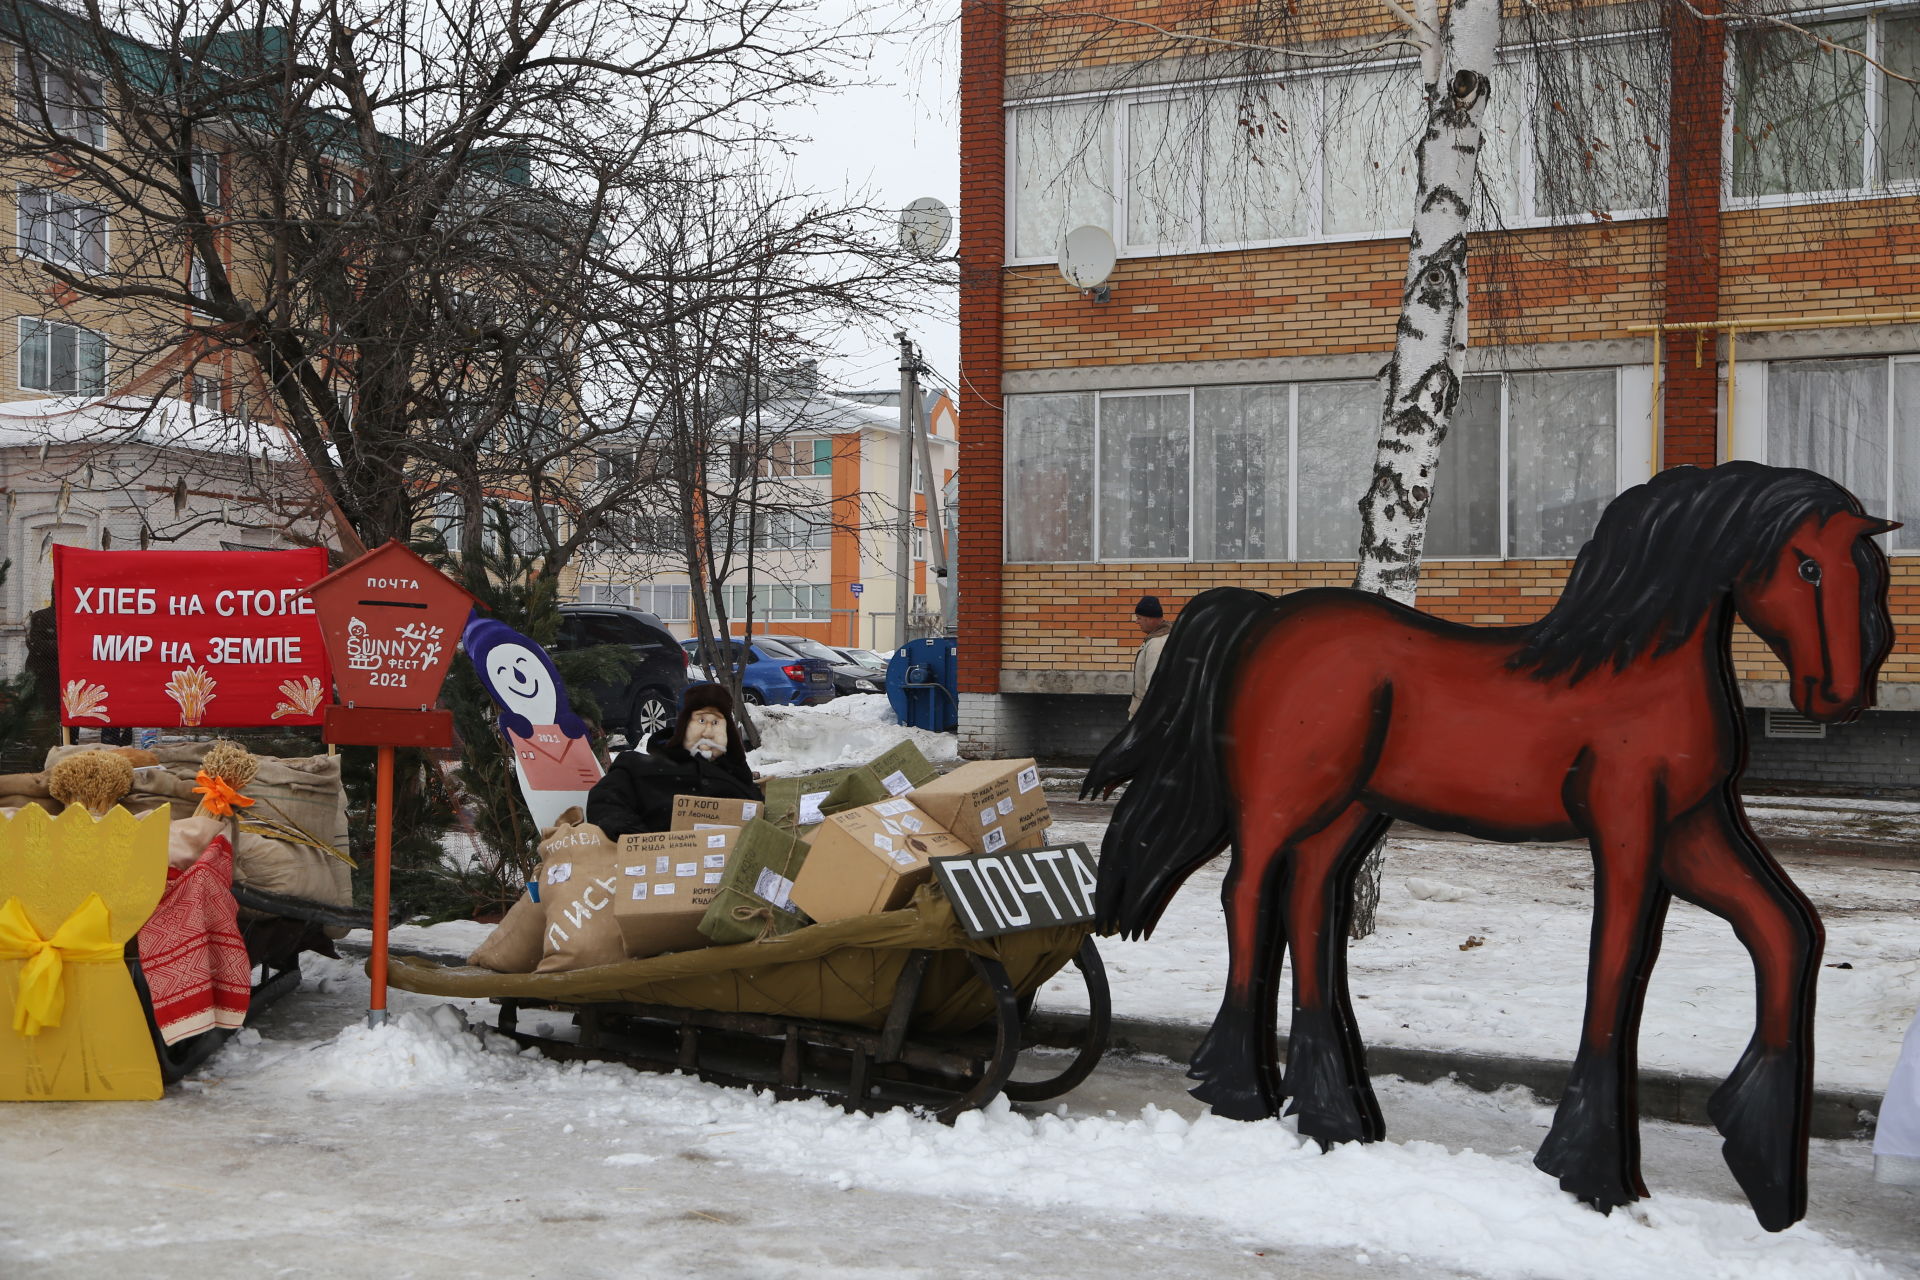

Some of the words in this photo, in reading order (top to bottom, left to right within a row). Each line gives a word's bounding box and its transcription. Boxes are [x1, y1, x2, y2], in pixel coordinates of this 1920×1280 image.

[367, 577, 420, 591] ПОЧТА
[74, 587, 156, 615] ХЛЕБ
[169, 594, 205, 616] НА
[215, 588, 316, 617] СТОЛЕ
[92, 634, 153, 662] МИР
[160, 641, 196, 663] НА
[206, 636, 302, 664] ЗЕМЛЕ
[347, 638, 421, 657] SUNNY
[388, 659, 419, 670] ФЕСТ
[369, 672, 407, 688] 2021
[537, 734, 561, 744] 2021
[677, 798, 690, 808] ОТ
[694, 800, 719, 810] КОГО
[627, 836, 640, 844] ОТ
[642, 834, 666, 843] КОГО
[641, 844, 665, 852] КУДА
[941, 848, 1098, 932] ПОЧТА
[548, 863, 618, 952] ПИСЬ
